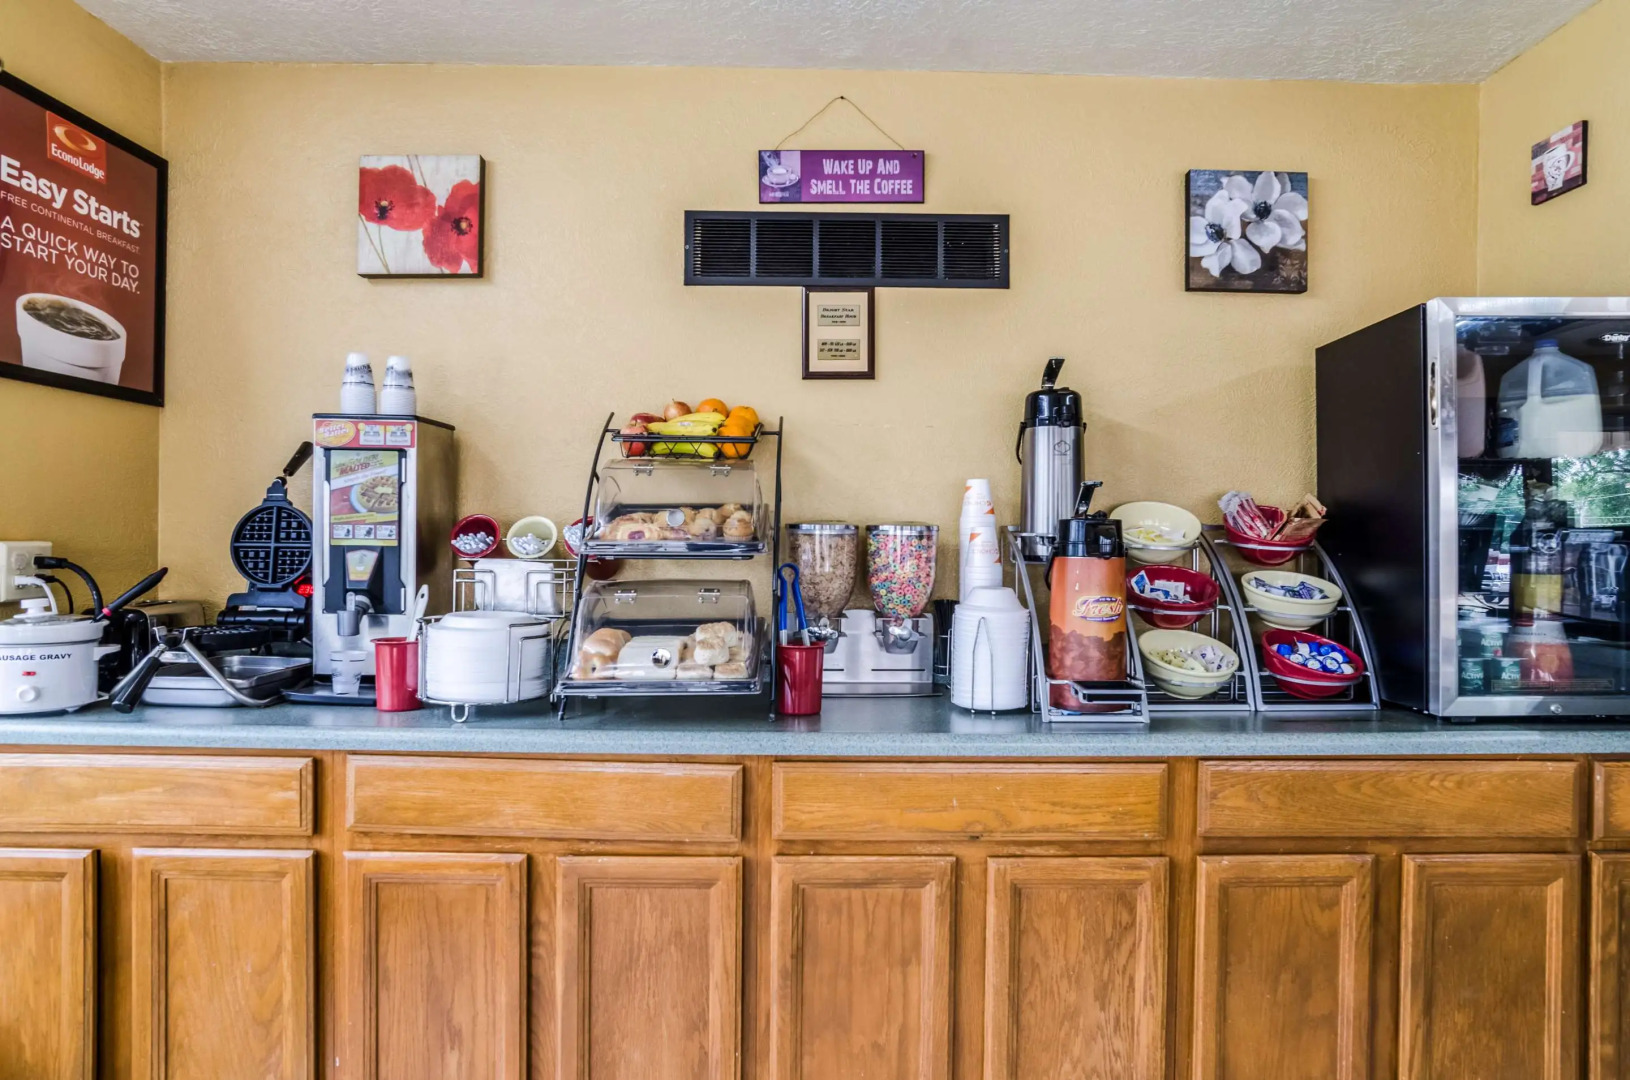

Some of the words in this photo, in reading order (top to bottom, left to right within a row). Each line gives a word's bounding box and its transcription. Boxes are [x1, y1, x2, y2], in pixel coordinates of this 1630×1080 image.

[51, 143, 105, 180] EconoLodge
[822, 158, 854, 175] WAKE
[857, 159, 873, 175] UP
[877, 158, 900, 175] AND
[1, 154, 68, 209] Easy
[72, 188, 140, 238] Starts
[810, 178, 846, 195] SMELL
[849, 179, 870, 195] THE
[874, 178, 913, 195] COFFEE
[0, 191, 28, 209] FREE
[30, 203, 94, 236] CONTINENTAL
[0, 215, 15, 233] A
[21, 222, 78, 255] QUICK
[83, 246, 117, 269] WAY
[121, 260, 139, 279] TO
[0, 232, 60, 264] START
[64, 254, 108, 282] YOUR
[112, 273, 140, 294] DAY.
[40, 653, 72, 661] GRAVY
